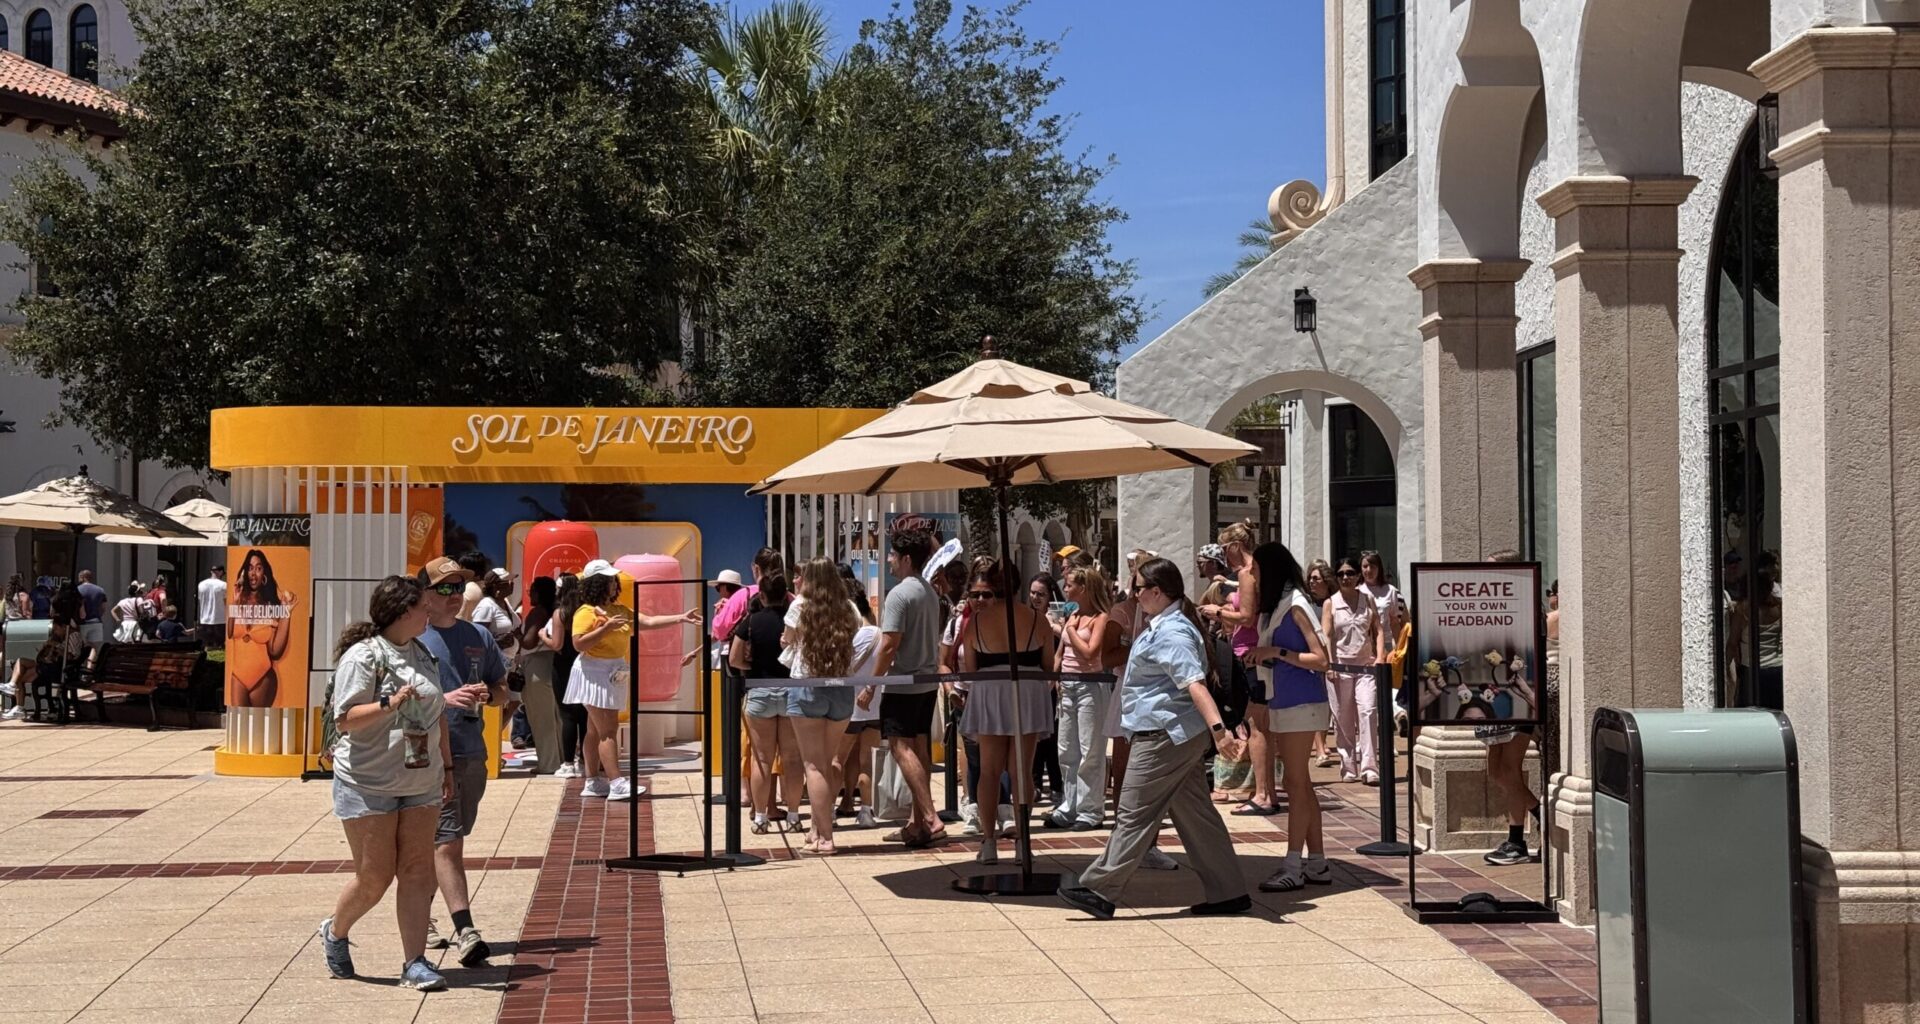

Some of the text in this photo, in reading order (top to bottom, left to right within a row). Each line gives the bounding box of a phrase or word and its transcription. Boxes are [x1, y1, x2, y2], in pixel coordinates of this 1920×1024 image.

[452, 413, 753, 455] SOL DE JANEIRO
[236, 518, 247, 529] DE
[917, 518, 931, 529] DE
[1437, 582, 1514, 598] CREATE
[242, 604, 253, 618] THE
[253, 604, 291, 619] DELICIOUS
[1445, 602, 1507, 611] YOUR OWN
[1438, 615, 1514, 627] HEADBAND
